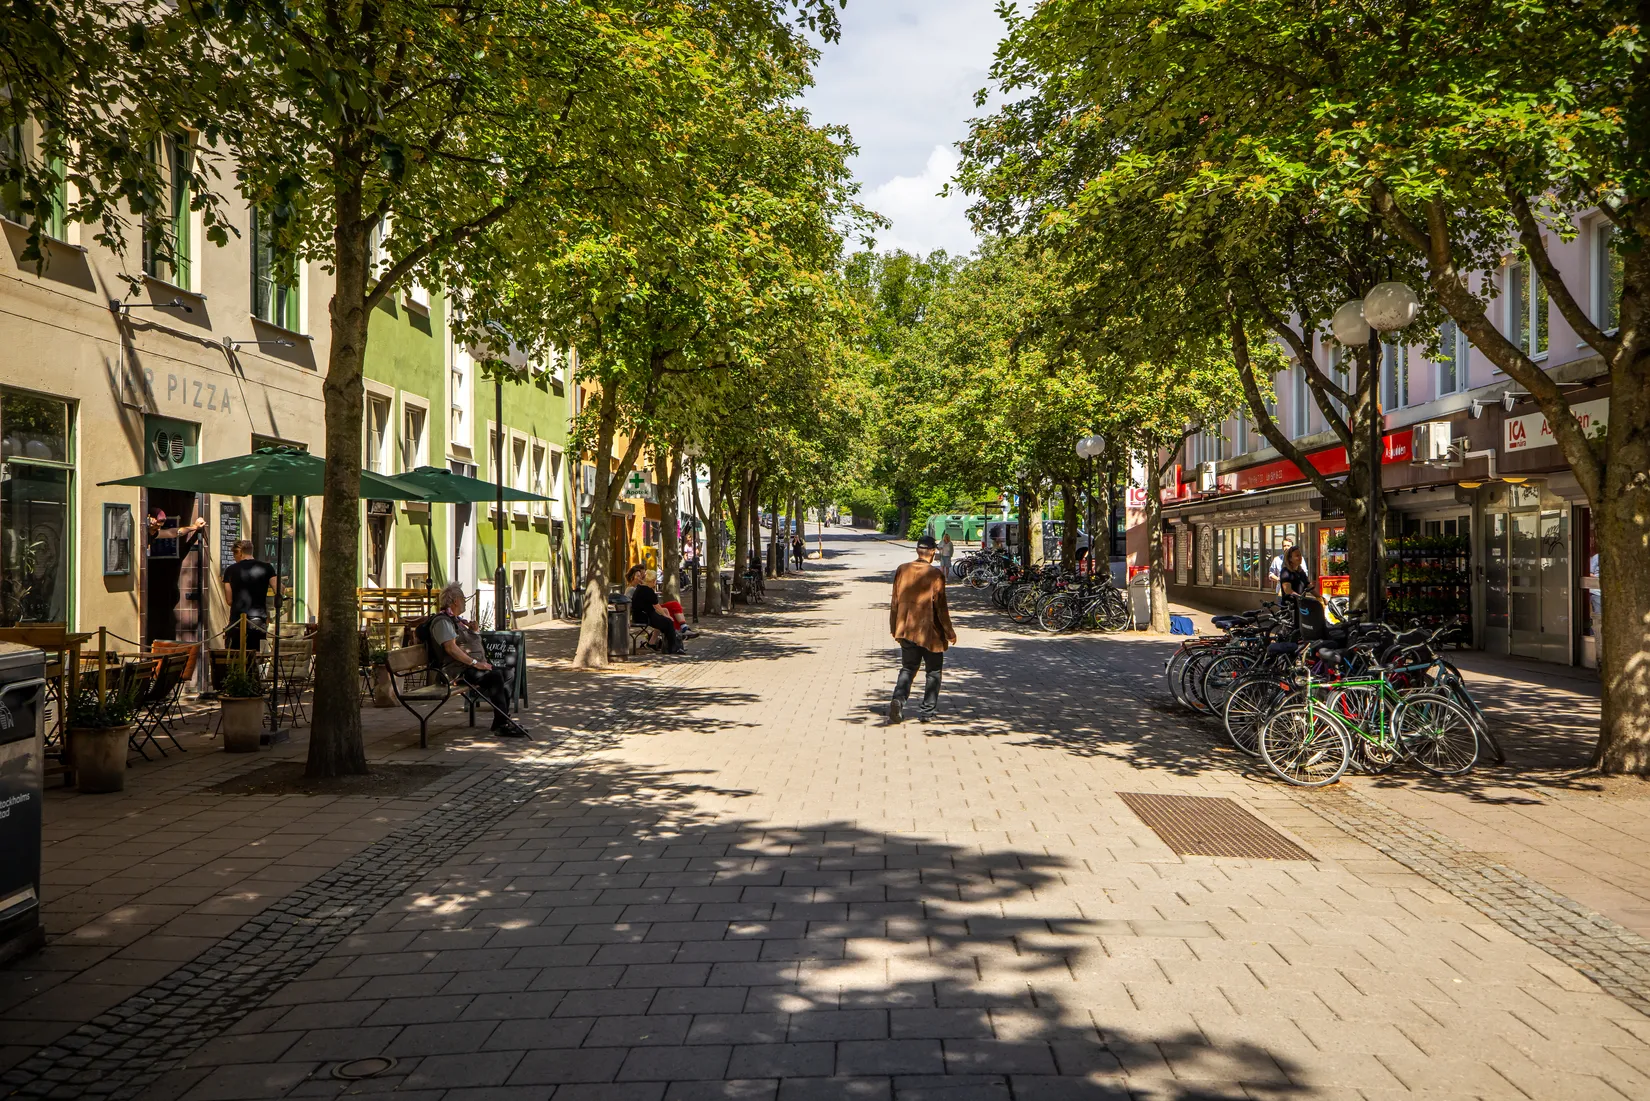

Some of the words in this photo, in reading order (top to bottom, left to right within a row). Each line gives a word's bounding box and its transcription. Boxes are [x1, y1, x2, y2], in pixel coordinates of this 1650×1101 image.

[167, 373, 232, 415] PIZZA
[1508, 420, 1526, 441] ICA
[1130, 488, 1149, 502] IC
[484, 638, 507, 652] unch
[0, 793, 30, 809] tockholms
[0, 807, 10, 819] tad
